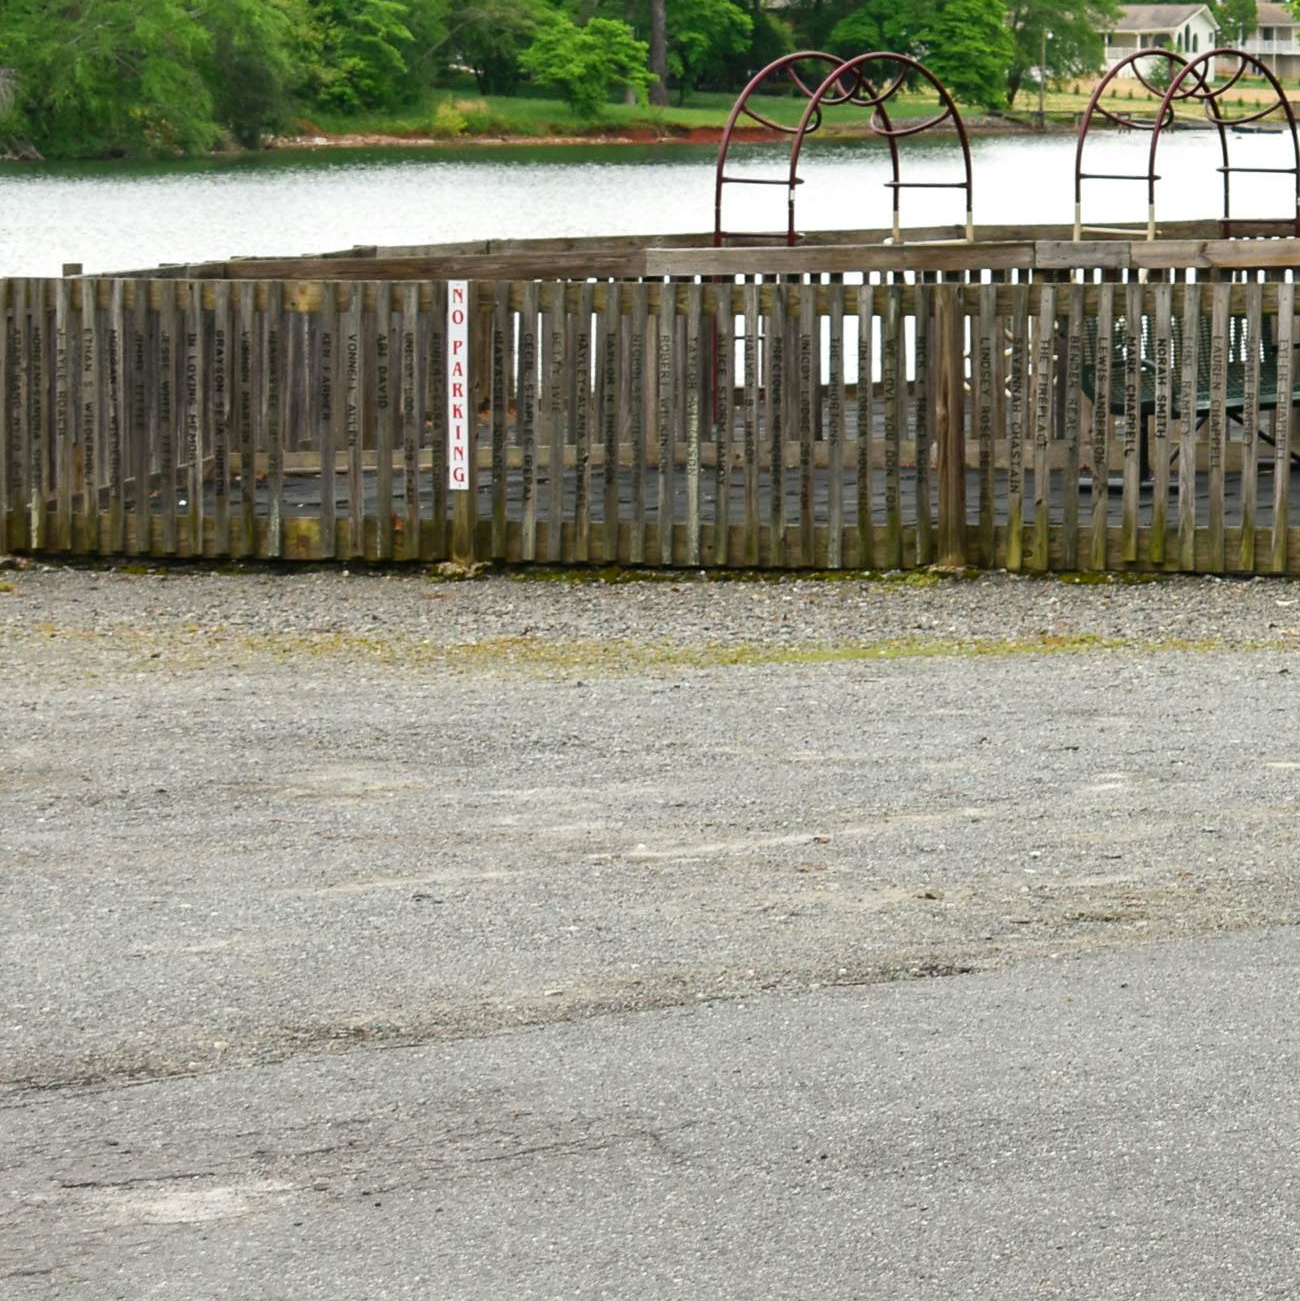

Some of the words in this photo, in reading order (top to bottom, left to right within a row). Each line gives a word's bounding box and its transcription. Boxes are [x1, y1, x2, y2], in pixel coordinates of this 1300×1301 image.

[452, 288, 464, 325] NO
[84, 328, 94, 371] ETHAN
[187, 333, 197, 346] IN
[322, 332, 332, 360] KEN
[524, 333, 535, 371] CECIL
[660, 335, 671, 386] ROBERT
[717, 334, 728, 375] ALICE
[801, 334, 811, 381] UNICOY
[830, 337, 840, 361] THE
[885, 339, 896, 358] WE
[1039, 338, 1050, 363] THE
[1098, 337, 1107, 382] LEWIS
[1126, 336, 1137, 375] MARK
[1156, 338, 1167, 385] NORAH
[187, 356, 197, 406] LOVING
[687, 336, 698, 389] TAYLOR
[980, 337, 991, 397] LINDSEY
[1011, 337, 1022, 413] SAVANNAH
[1212, 335, 1223, 391] LAUREN
[321, 366, 332, 420] FARMER
[378, 365, 388, 409] DAVID
[717, 386, 727, 432] STORM
[885, 369, 896, 404] LOVE
[241, 391, 251, 444] MARTIN
[347, 404, 357, 446] ALLEN
[452, 340, 465, 483] PARKING
[801, 391, 811, 434] LODGE
[885, 414, 896, 440] YOU
[979, 405, 991, 440] ROSE
[1036, 373, 1049, 451] FIREPLACE
[1094, 392, 1106, 465] ANDERSON
[1124, 384, 1136, 458] CHAPPELL
[1155, 394, 1167, 439] SMITH
[187, 414, 197, 469] MEMORY
[1009, 421, 1021, 494] CHASTAIN
[1210, 399, 1222, 471] CHAPPELL
[886, 450, 896, 476] DON
[886, 485, 897, 513] FOX
